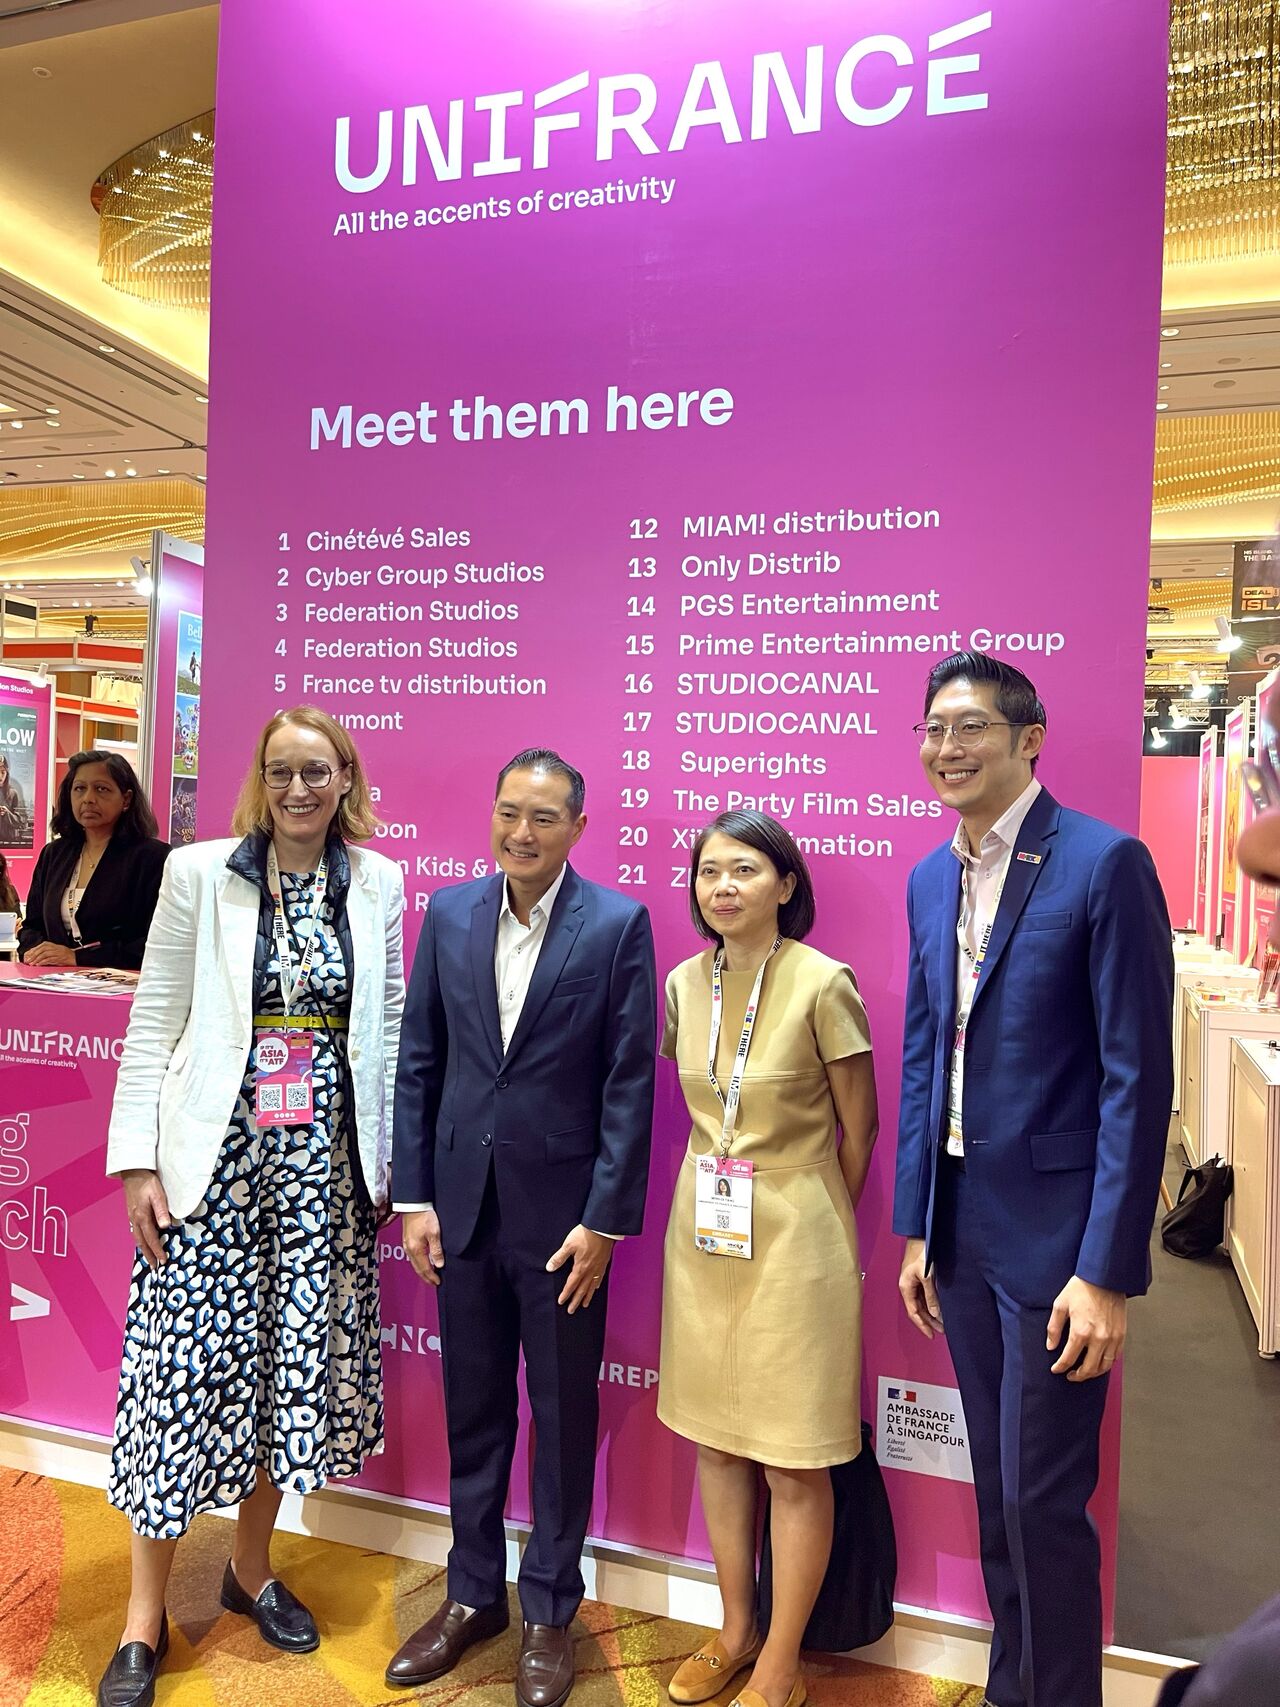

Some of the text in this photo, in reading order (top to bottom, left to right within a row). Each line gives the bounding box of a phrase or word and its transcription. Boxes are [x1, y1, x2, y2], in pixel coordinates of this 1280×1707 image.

[334, 177, 675, 235] All the accents of creativity
[311, 386, 733, 449] Meet them here
[630, 507, 939, 538] 12 MIAM! distribution
[279, 527, 470, 551] 1 Cinétévé Sales
[278, 562, 544, 591] 2 Cyber Group Studios
[629, 551, 840, 581] 13 Only Distrib
[276, 600, 518, 622] 3 Federation Studios
[627, 590, 939, 616] 14 PGS Entertainment
[275, 637, 517, 657] 4 Federation Studios
[626, 629, 1065, 656] 15 Prime Entertainment Group
[10, 684, 34, 695] Studios
[275, 674, 546, 694] 5 France tv distribution
[625, 672, 879, 694] 16 STUDIOCANAL
[624, 712, 877, 734] 17 STUDIOCANAL
[623, 751, 826, 778] 18 Superights
[621, 789, 942, 818] 19 The Party Film Sales
[620, 826, 648, 846] 20
[671, 828, 700, 849] Xi
[417, 856, 465, 877] Kids
[471, 859, 489, 879] &
[618, 864, 646, 884] 21
[260, 1050, 287, 1058] ASIA,
[738, 1038, 748, 1057] HERE
[15, 1056, 40, 1065] accents
[47, 1060, 77, 1069] creativity
[887, 1403, 956, 1423] AMBASSADE
[887, 1414, 949, 1434] DE FRANCE
[886, 1423, 965, 1448] À SINGAPOUR
